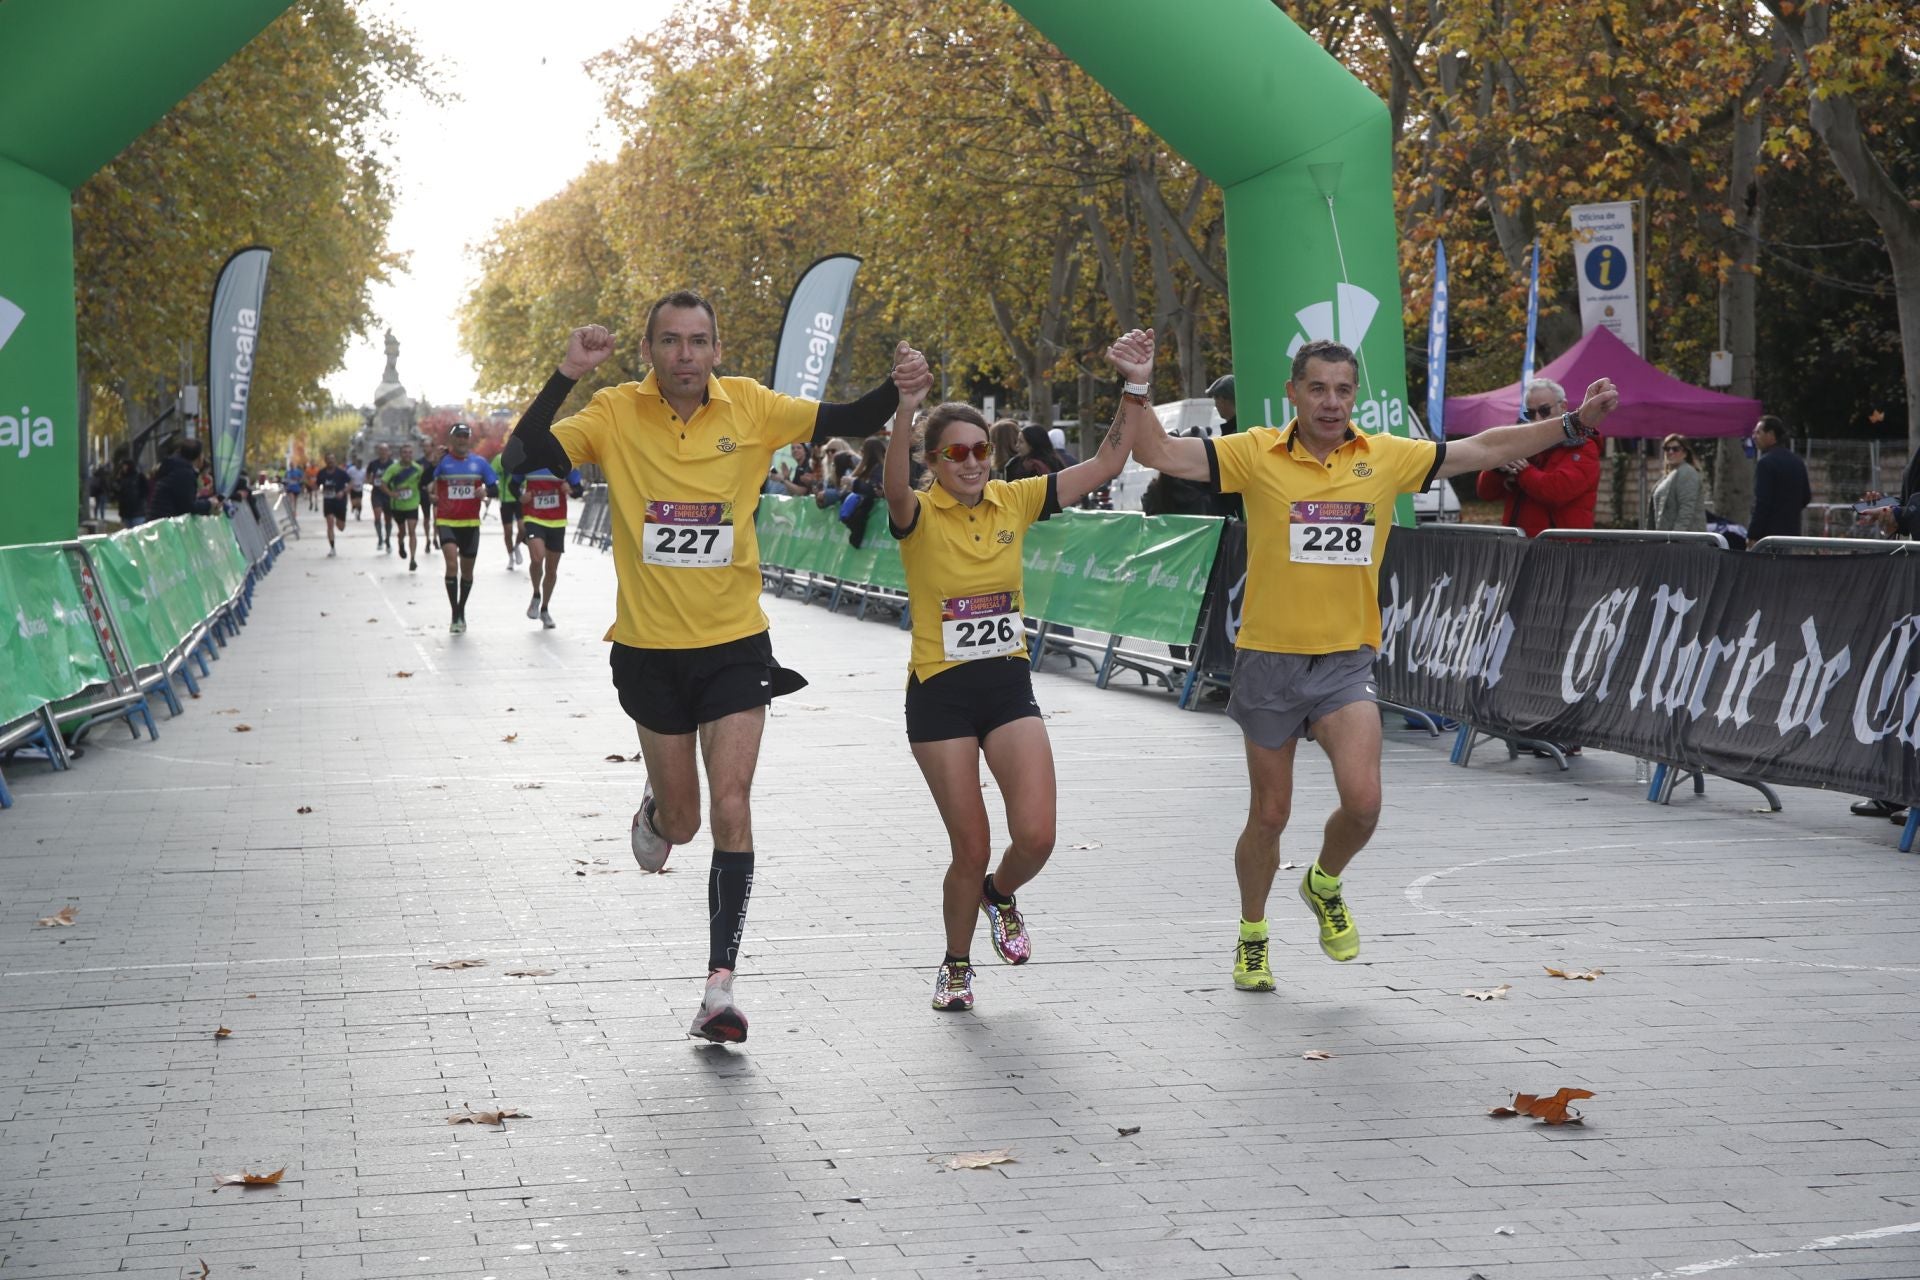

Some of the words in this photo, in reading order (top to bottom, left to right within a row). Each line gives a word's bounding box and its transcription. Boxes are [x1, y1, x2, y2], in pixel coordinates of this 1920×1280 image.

[1578, 213, 1604, 222] Oficina
[1606, 212, 1615, 220] de
[230, 308, 256, 426] Unicaja
[797, 312, 835, 401] nicaja
[1264, 389, 1403, 433] Uaja
[452, 487, 471, 496] 760
[662, 504, 674, 516] 9ª
[1307, 503, 1318, 516] 9ª
[655, 527, 720, 554] 227
[1302, 526, 1362, 552] 228
[958, 600, 969, 611] 9ª
[970, 596, 993, 604] CARRERA
[970, 601, 1000, 611] EMPRESAS
[956, 617, 1014, 648] 226
[1561, 586, 1639, 704] El
[1629, 584, 1776, 731] Norte
[1774, 615, 1850, 739] de
